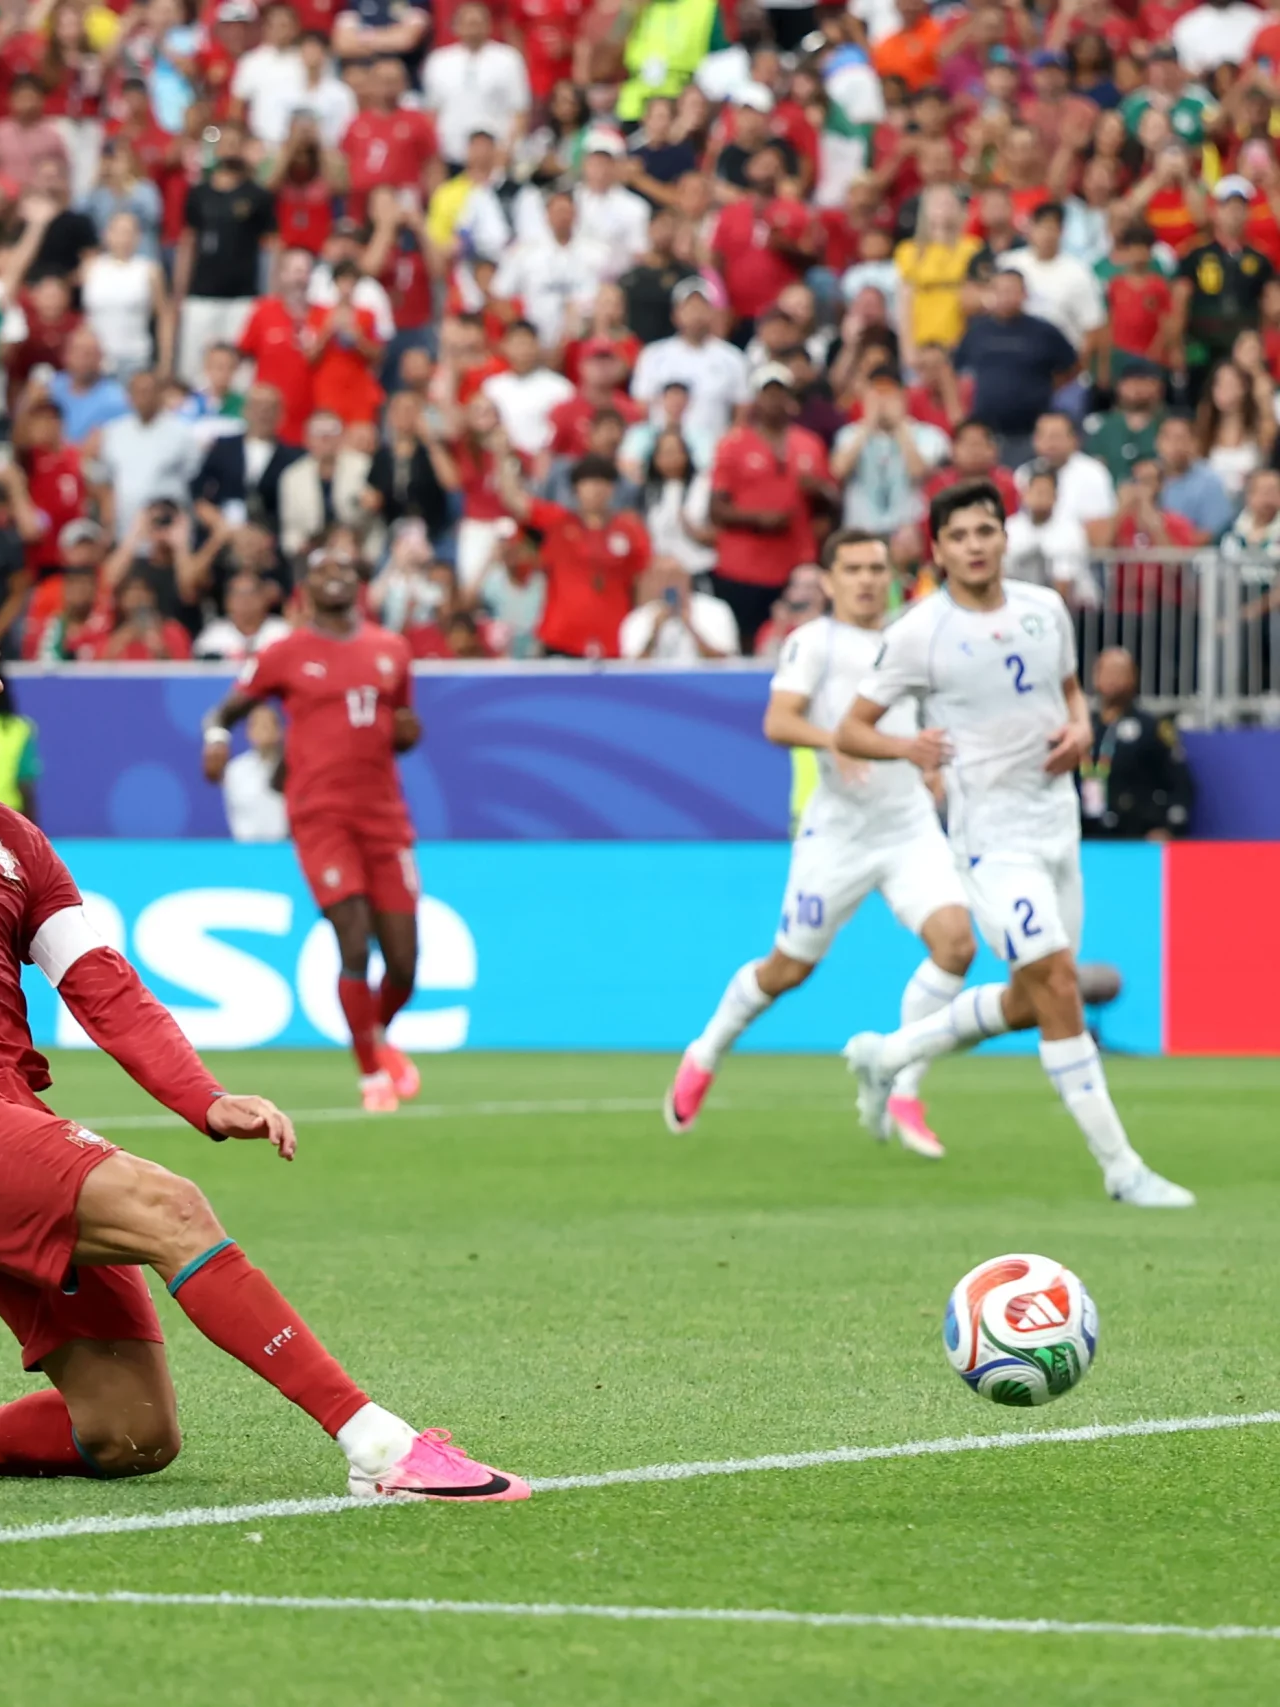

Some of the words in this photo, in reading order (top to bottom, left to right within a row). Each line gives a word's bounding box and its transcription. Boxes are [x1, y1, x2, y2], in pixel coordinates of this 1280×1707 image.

[1005, 653, 1034, 695] 2
[796, 890, 824, 929] 10
[1013, 897, 1043, 939] 2
